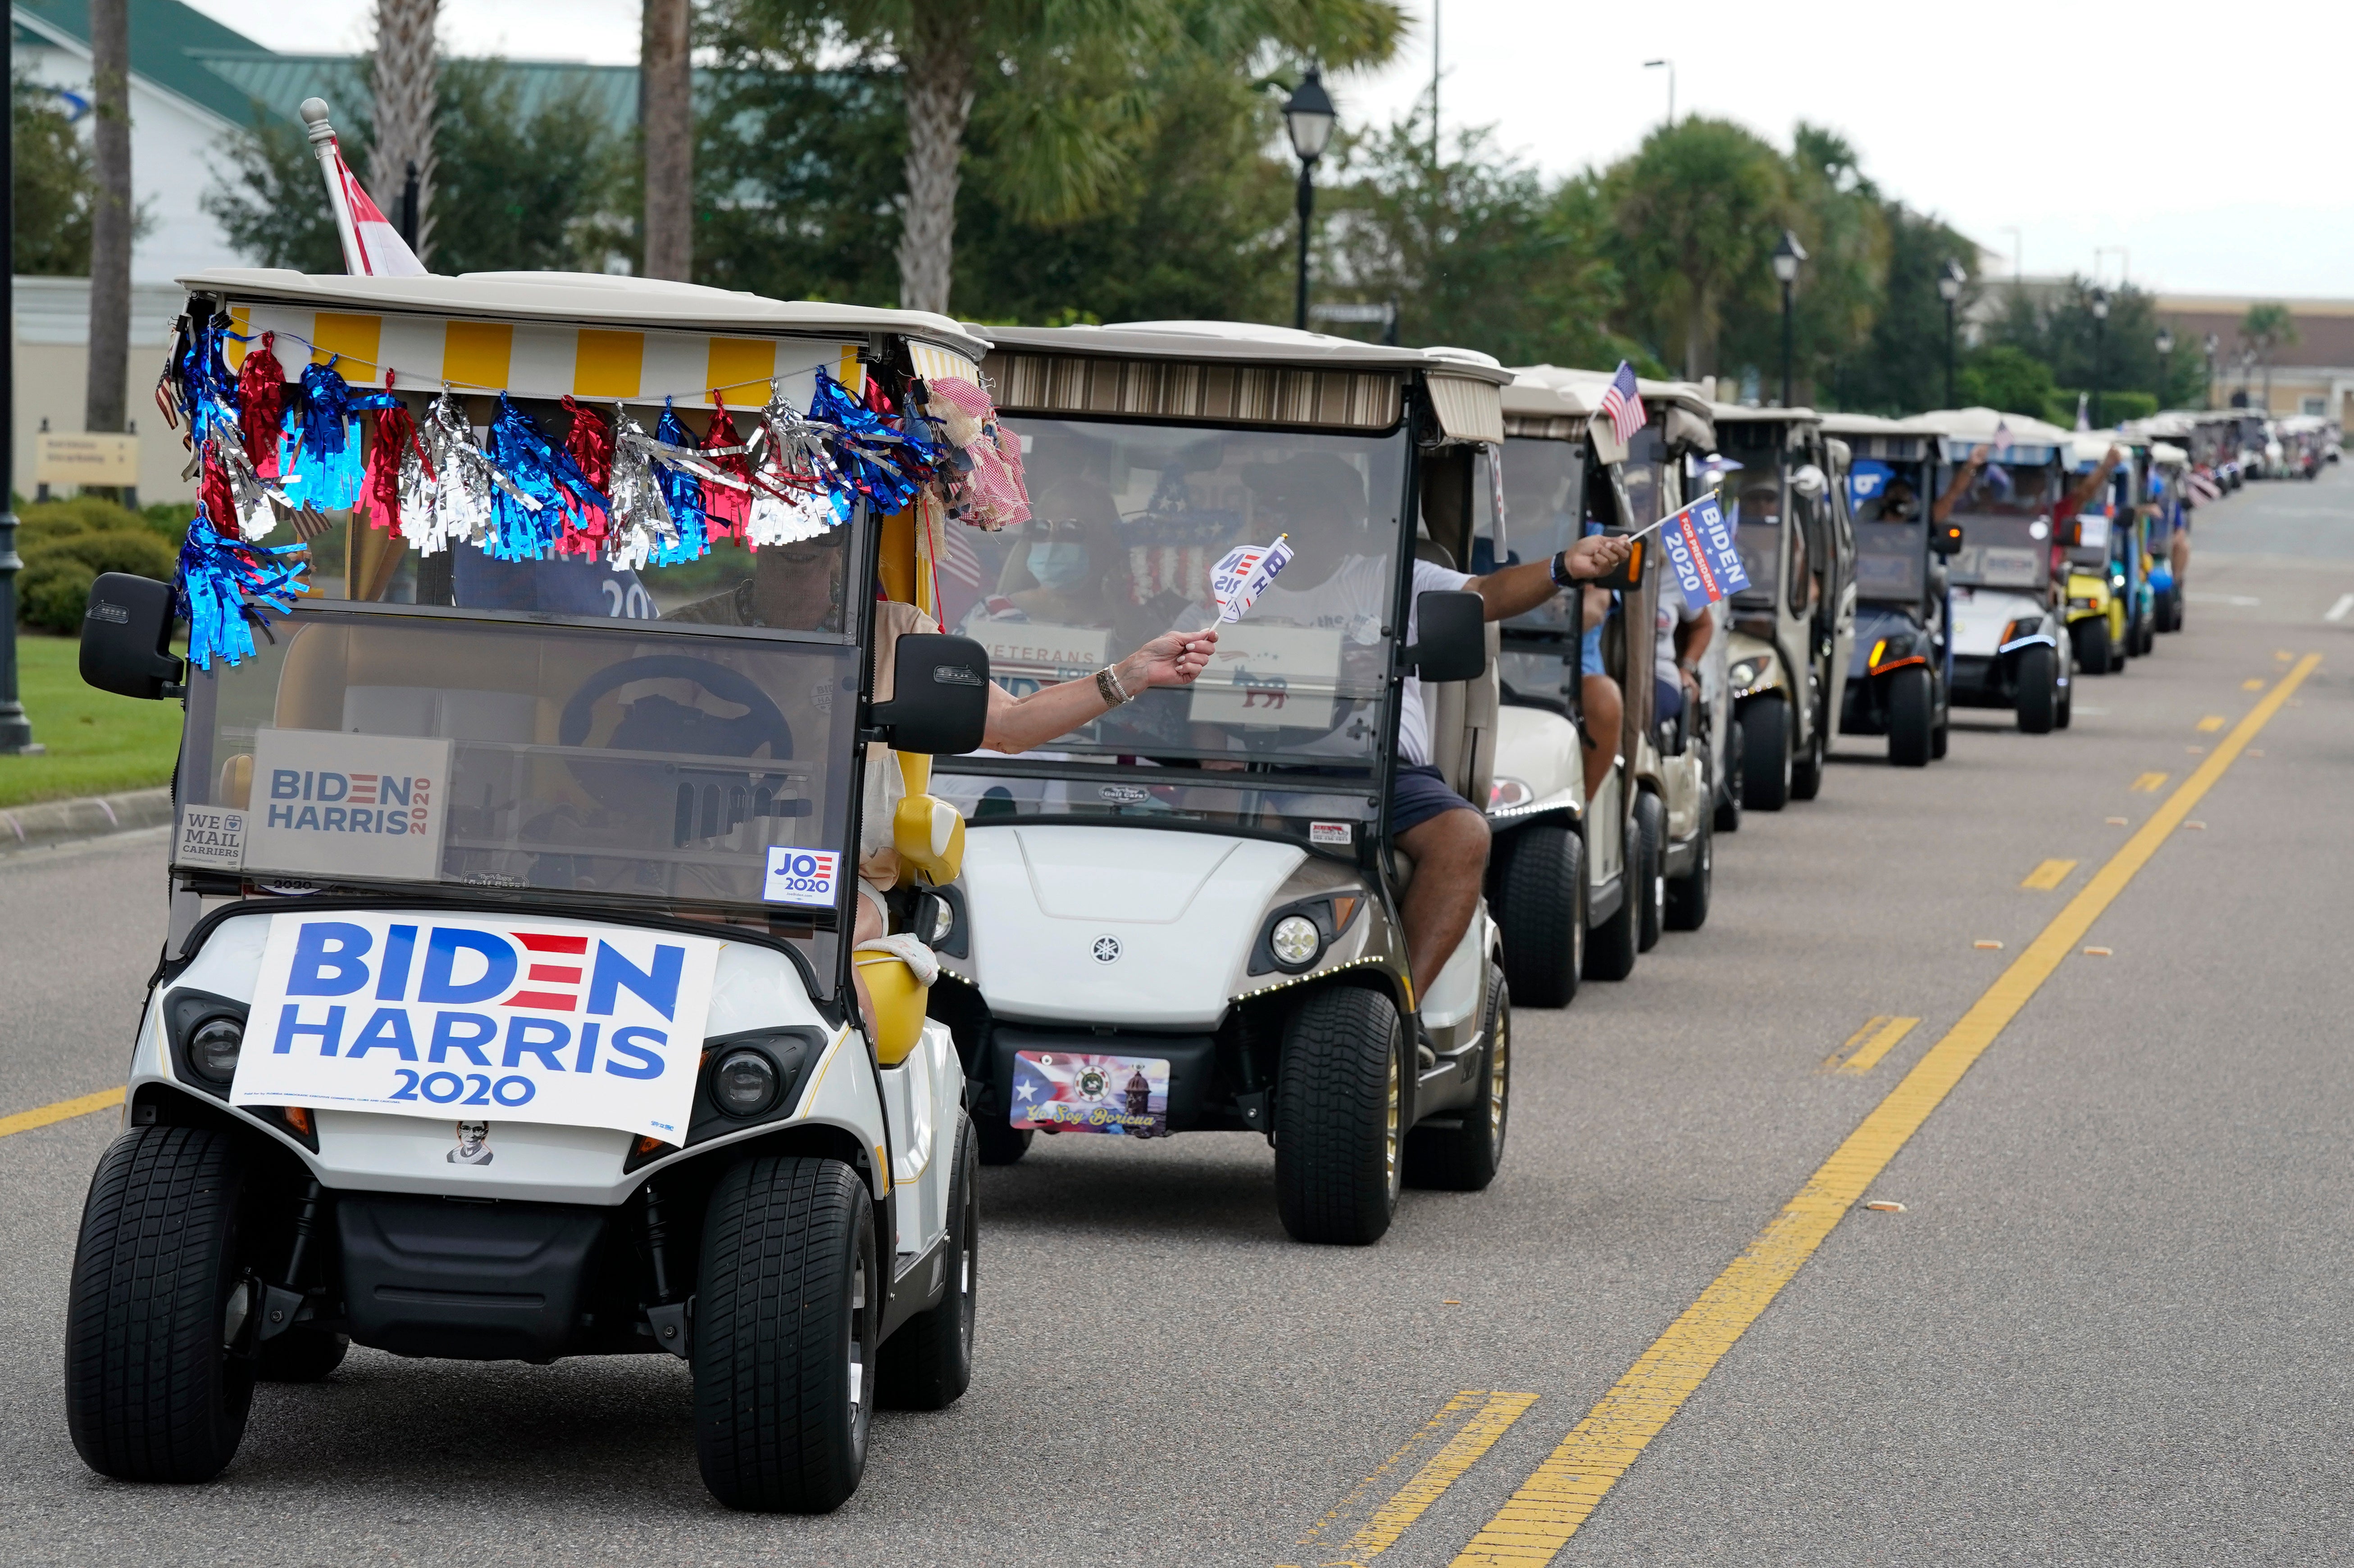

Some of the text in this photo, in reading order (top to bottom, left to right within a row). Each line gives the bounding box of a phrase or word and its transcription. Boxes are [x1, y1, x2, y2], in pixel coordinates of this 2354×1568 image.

[1665, 532, 1700, 591] 2020
[1681, 518, 1717, 593] FOR PRESIDENT
[1701, 507, 1744, 584] BIDEN
[271, 769, 411, 806] BIDEN
[188, 814, 220, 829] WE
[268, 804, 408, 835] HARRIS
[410, 778, 431, 836] 2020
[183, 845, 239, 857] CARRIERS
[185, 829, 240, 847] MAIL
[774, 853, 833, 878] JOE
[274, 879, 312, 889] 2020
[785, 877, 829, 893] 2020
[285, 922, 685, 1023] BIDEN
[273, 1004, 668, 1080] HARRIS
[388, 1068, 536, 1108] 2020
[1026, 1104, 1156, 1126] Yo Soy Boricua
